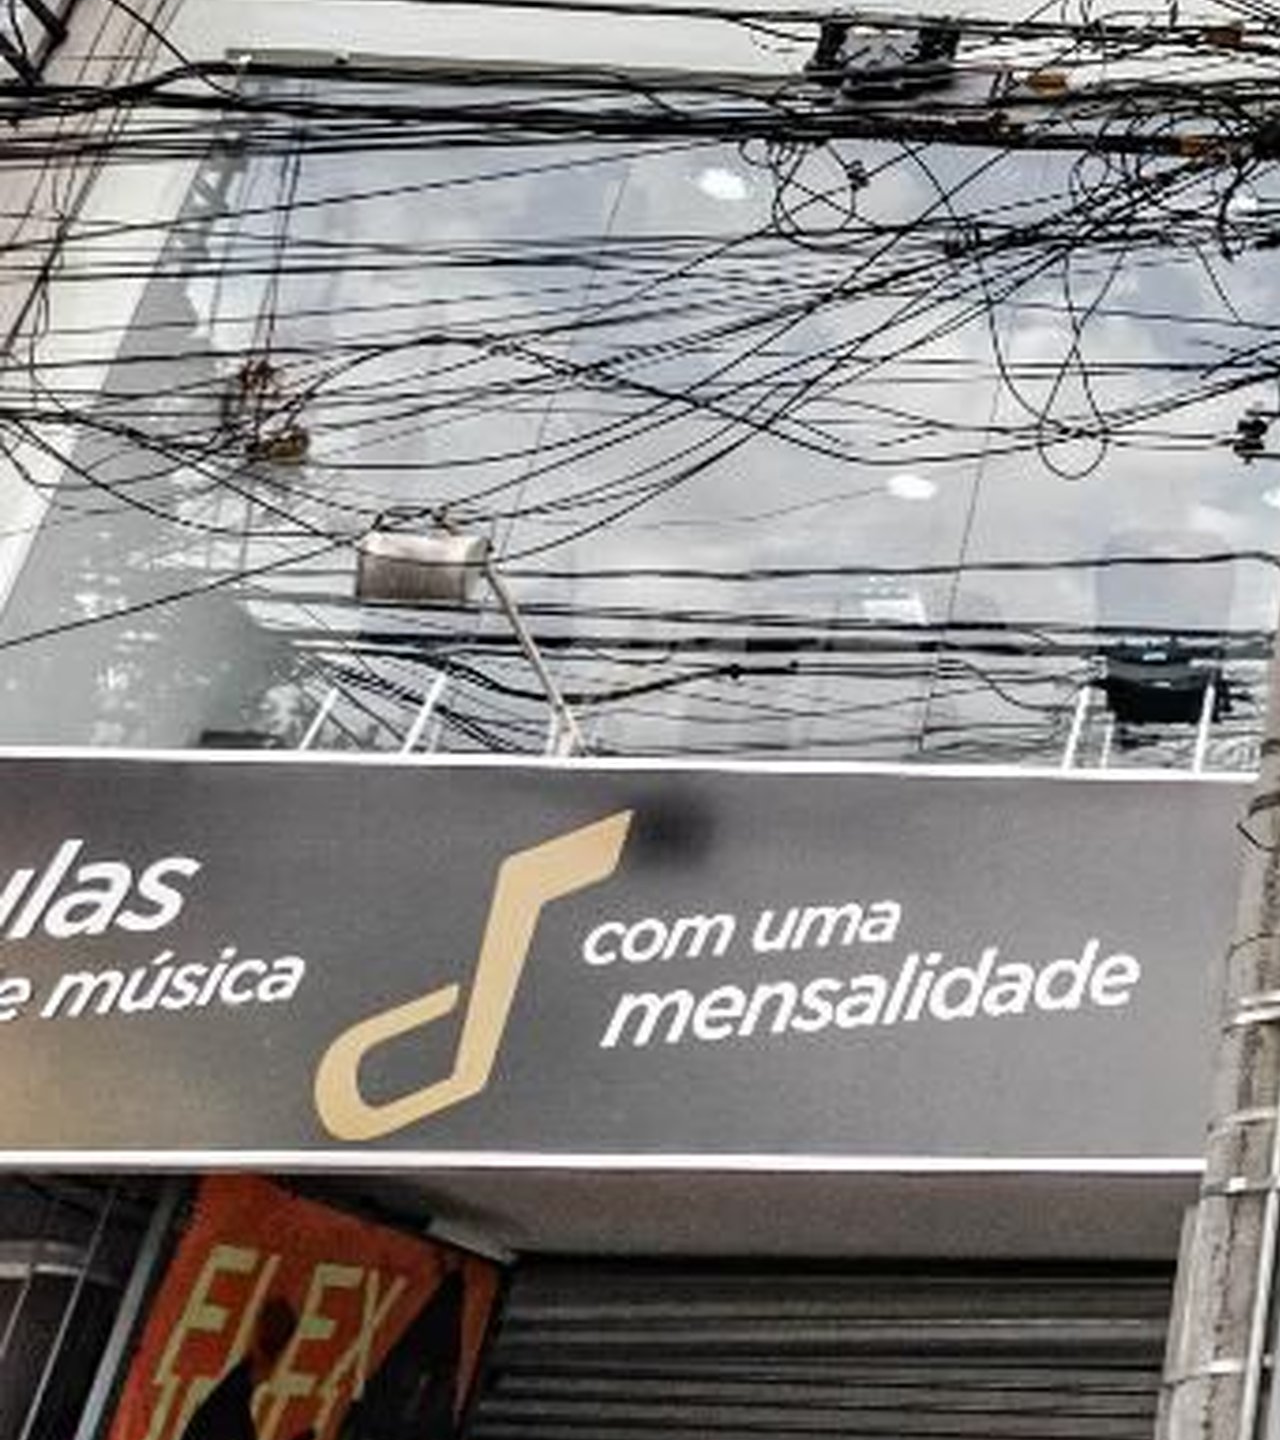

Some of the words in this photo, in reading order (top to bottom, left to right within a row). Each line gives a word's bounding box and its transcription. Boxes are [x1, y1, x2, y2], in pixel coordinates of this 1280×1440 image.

[582, 913, 736, 966] com
[751, 896, 904, 952] uma
[39, 947, 306, 1018] música
[599, 937, 1142, 1048] mensalidade
